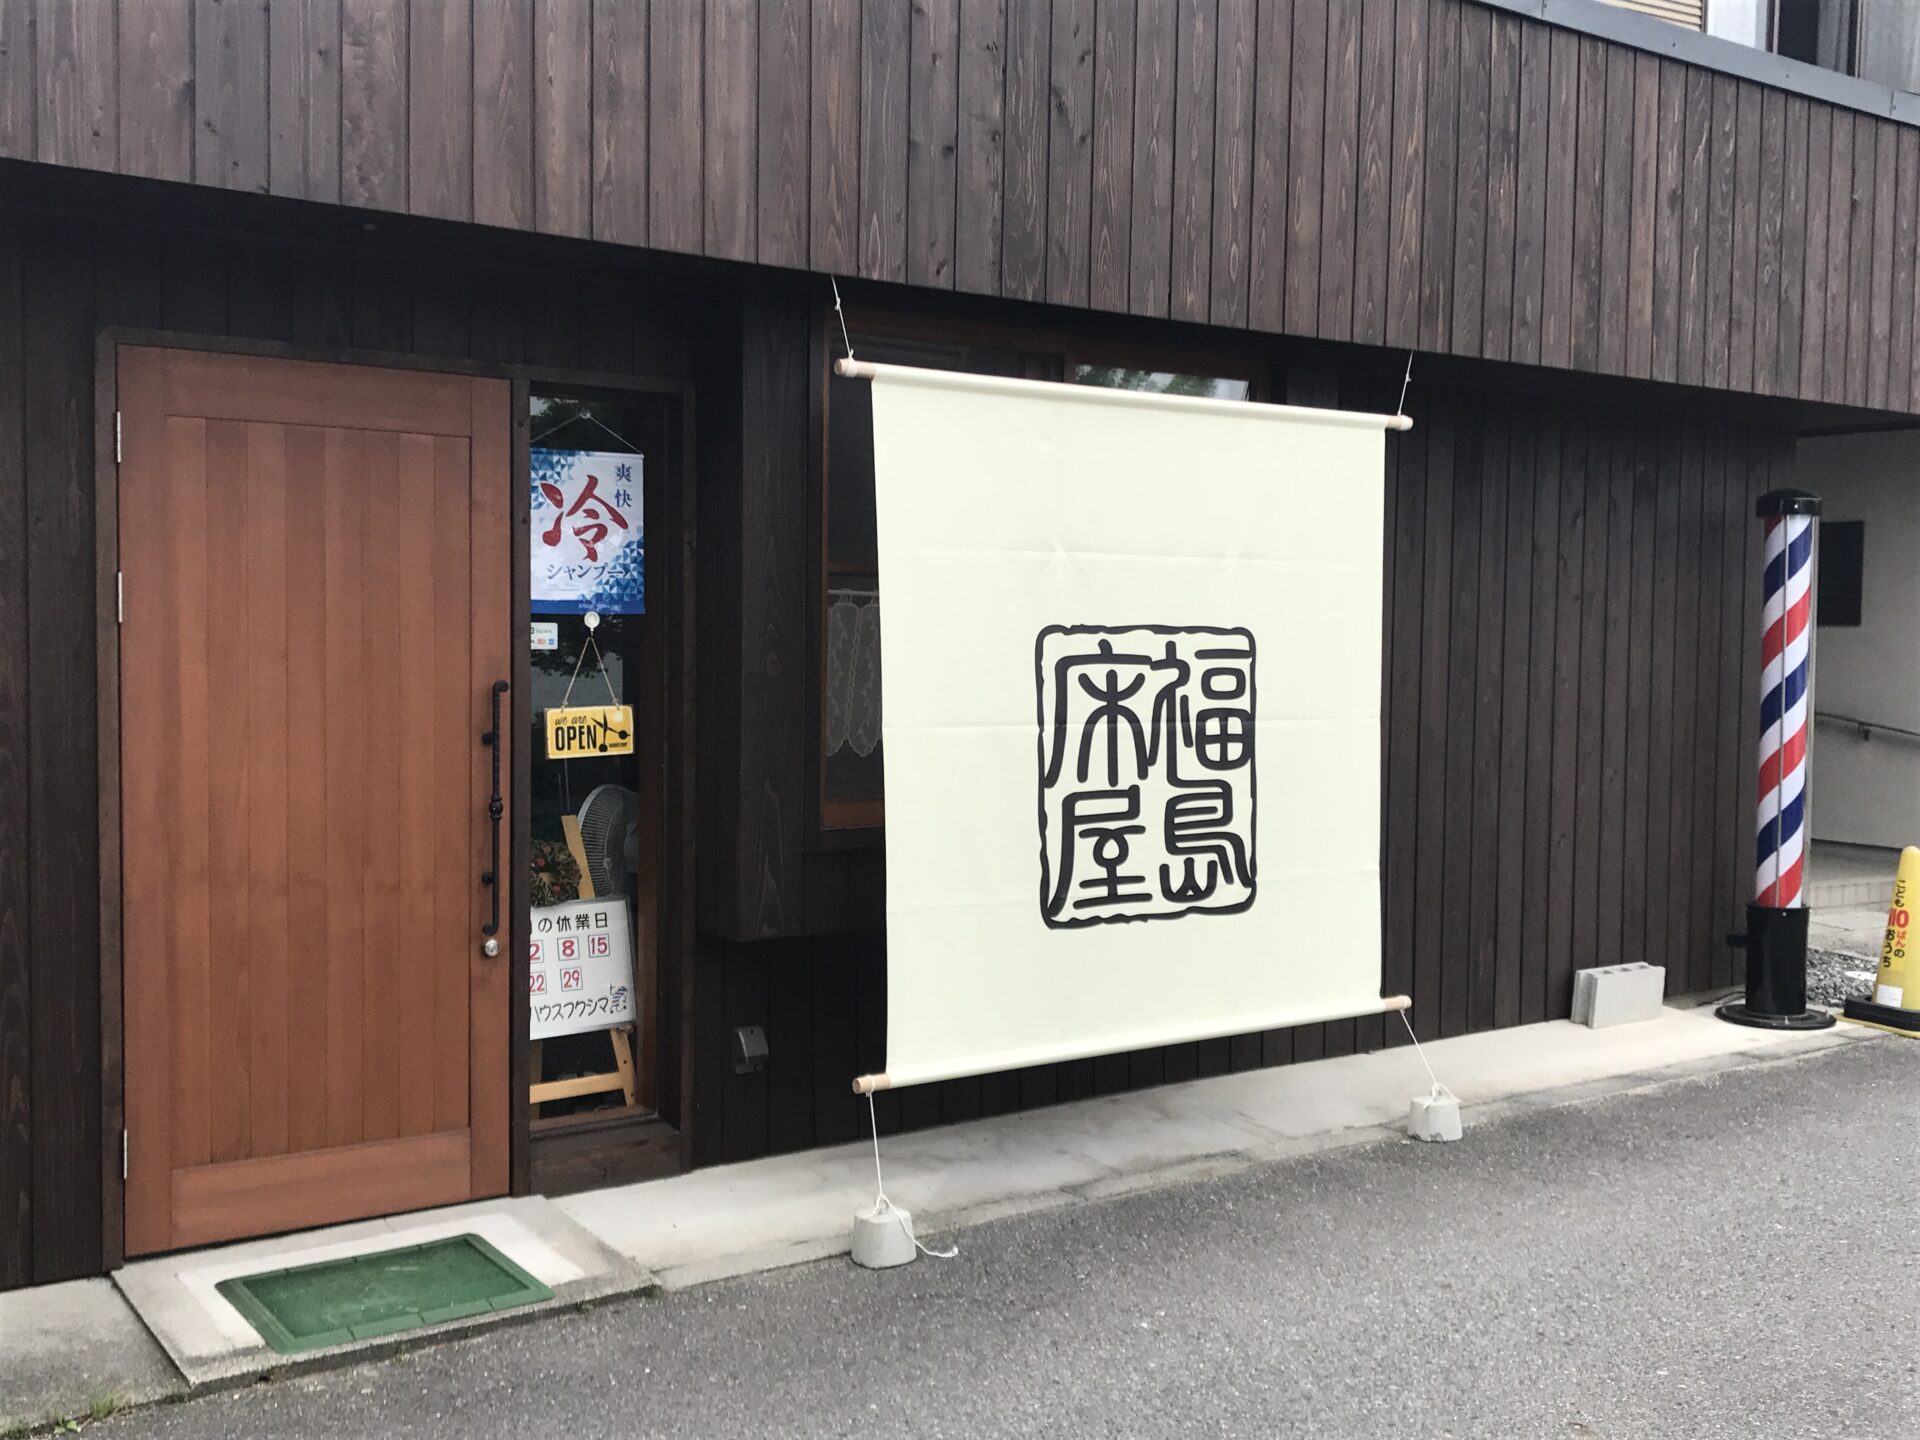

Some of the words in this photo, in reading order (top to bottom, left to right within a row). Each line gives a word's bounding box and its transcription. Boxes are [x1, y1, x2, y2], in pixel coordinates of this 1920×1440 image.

[614, 463, 632, 508] 爽快
[540, 474, 629, 563] 冷
[547, 562, 625, 581] シャンプー
[571, 714, 587, 725] are
[555, 724, 597, 752] OPEN
[538, 912, 608, 933] の休業日
[562, 940, 575, 958] 8
[590, 937, 608, 954] 15
[1883, 928, 1895, 968] おうち
[563, 969, 580, 989] 29
